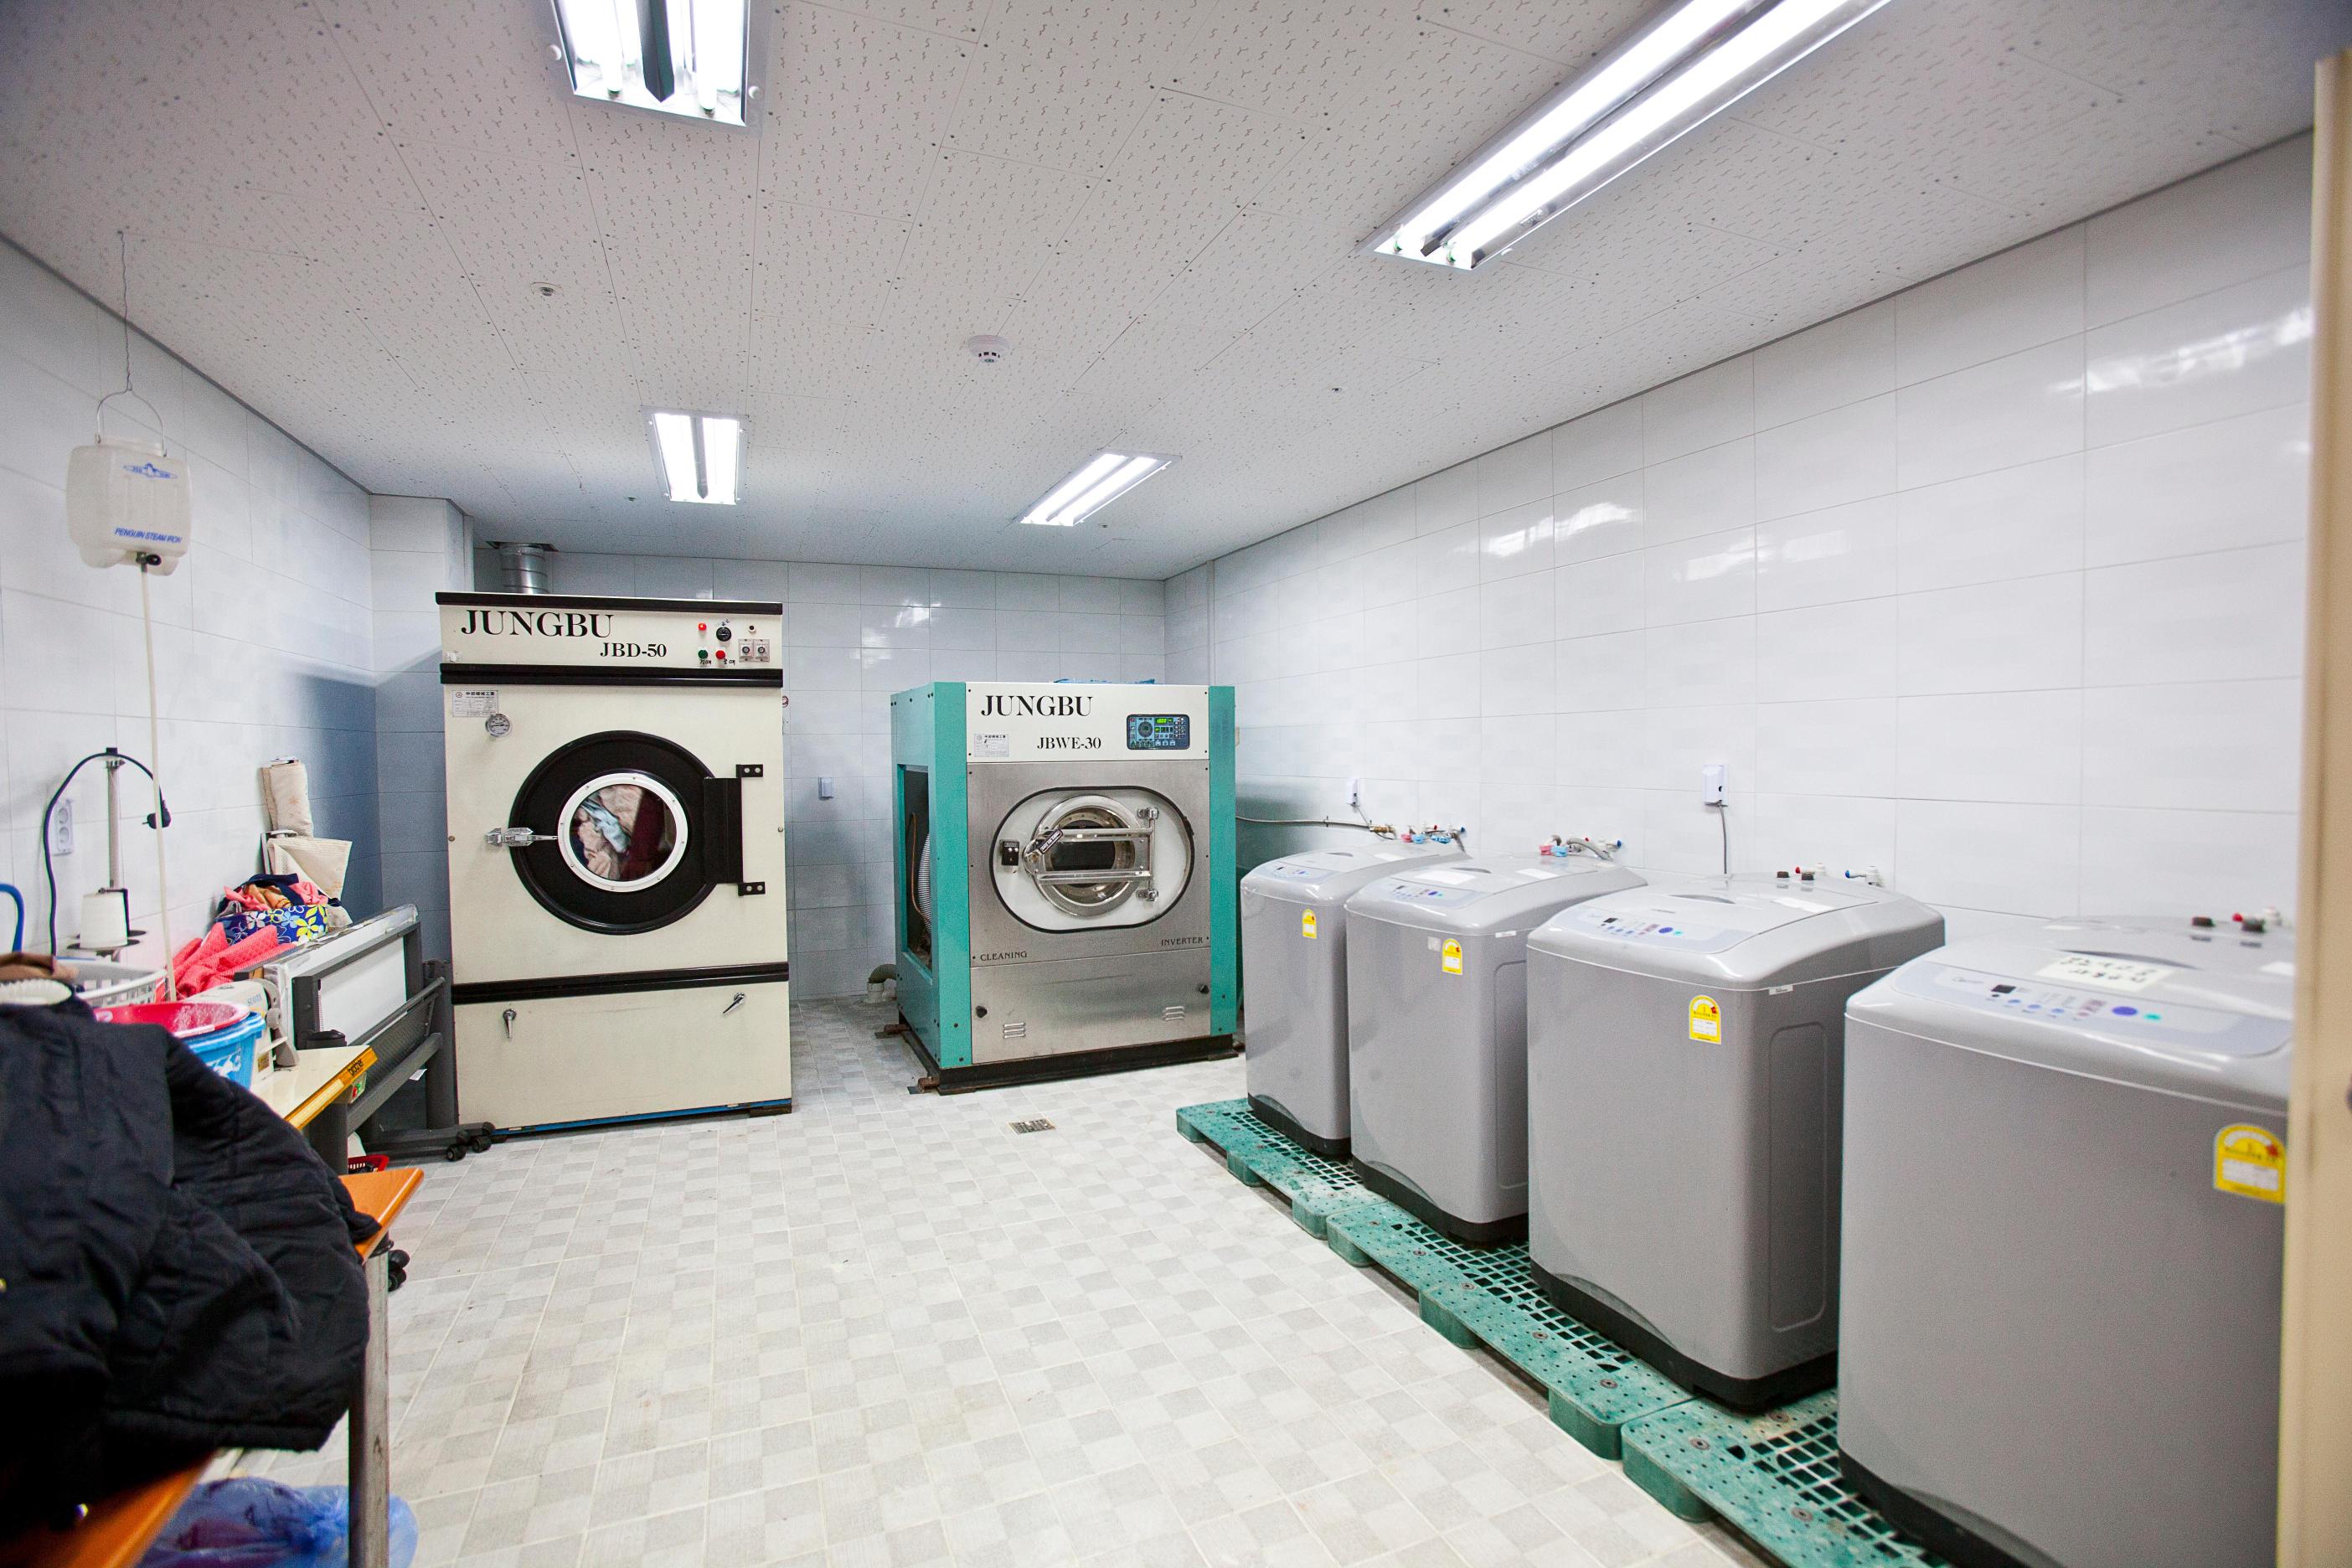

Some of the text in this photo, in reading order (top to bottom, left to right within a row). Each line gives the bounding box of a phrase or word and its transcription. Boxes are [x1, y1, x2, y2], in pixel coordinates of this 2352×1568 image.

[115, 528, 145, 539] PENGUIN
[146, 532, 166, 541] STEAM
[461, 609, 615, 638] JUNGBU
[600, 642, 667, 658] JBD-50
[981, 694, 1093, 717] JUNGBU
[1037, 736, 1101, 750] JBWE-30
[1161, 936, 1204, 946] INVERTER
[980, 951, 1028, 962] CLEANING
[348, 1059, 363, 1075] brother
